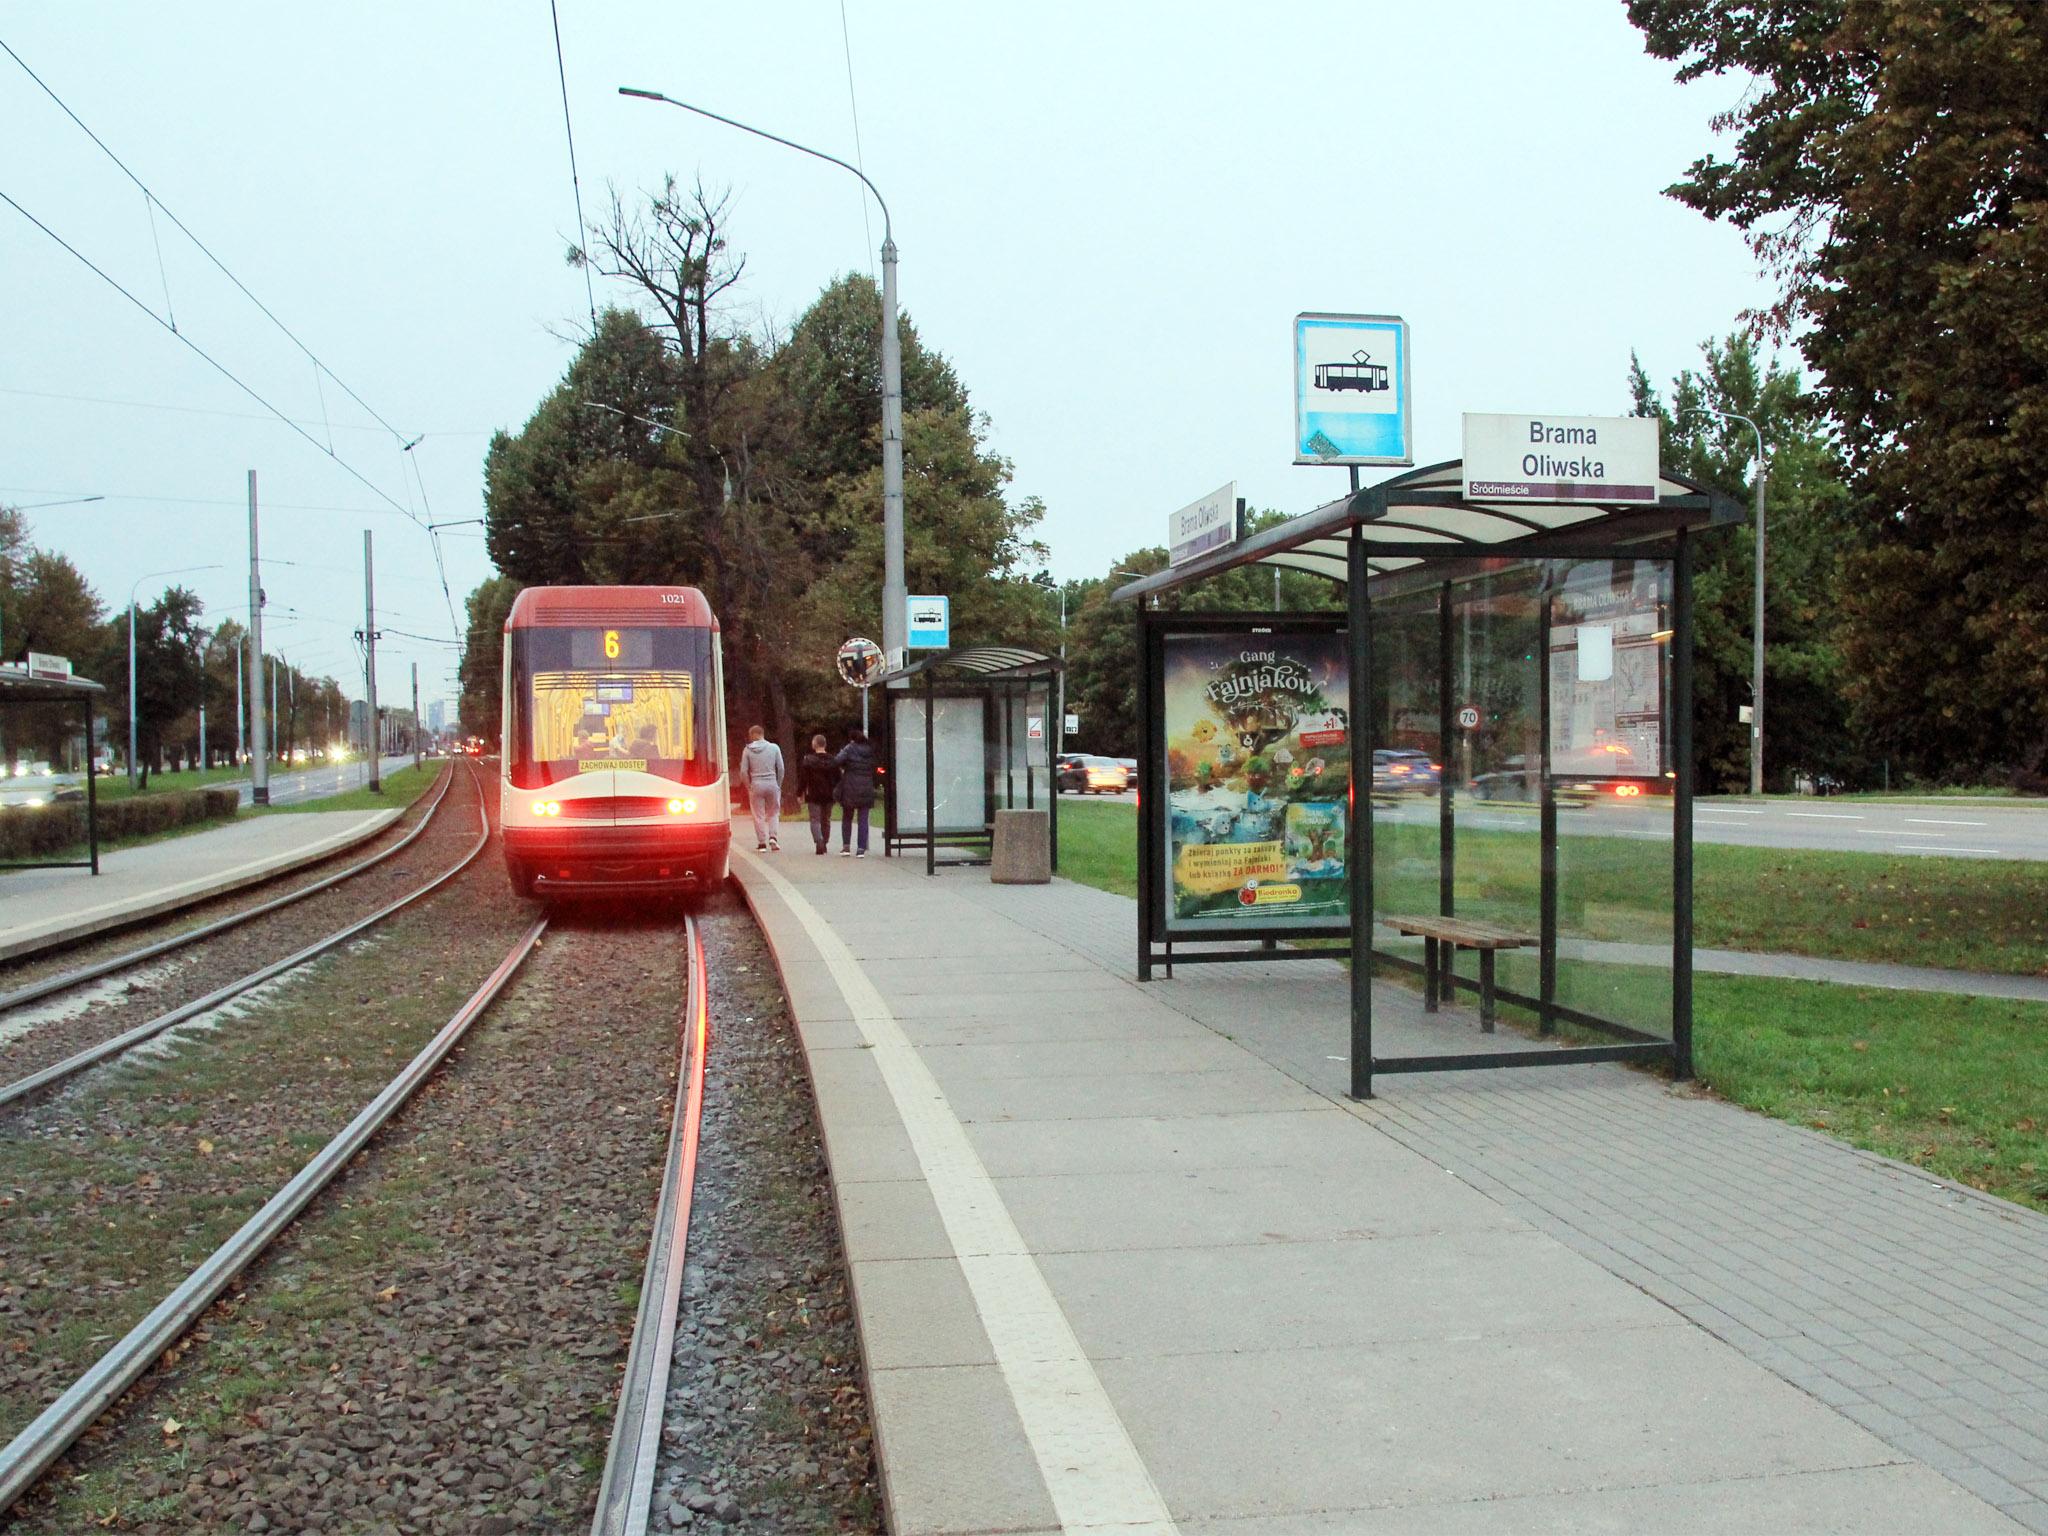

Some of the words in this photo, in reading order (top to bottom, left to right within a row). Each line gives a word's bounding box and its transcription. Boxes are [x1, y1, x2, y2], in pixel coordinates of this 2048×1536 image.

[1530, 421, 1597, 445] Brama
[1522, 454, 1604, 478] Oliwska
[1472, 482, 1530, 495] Śródmieście
[661, 594, 685, 604] 1021
[605, 630, 620, 659] 6
[1240, 650, 1275, 664] Gang
[1462, 712, 1477, 723] 70
